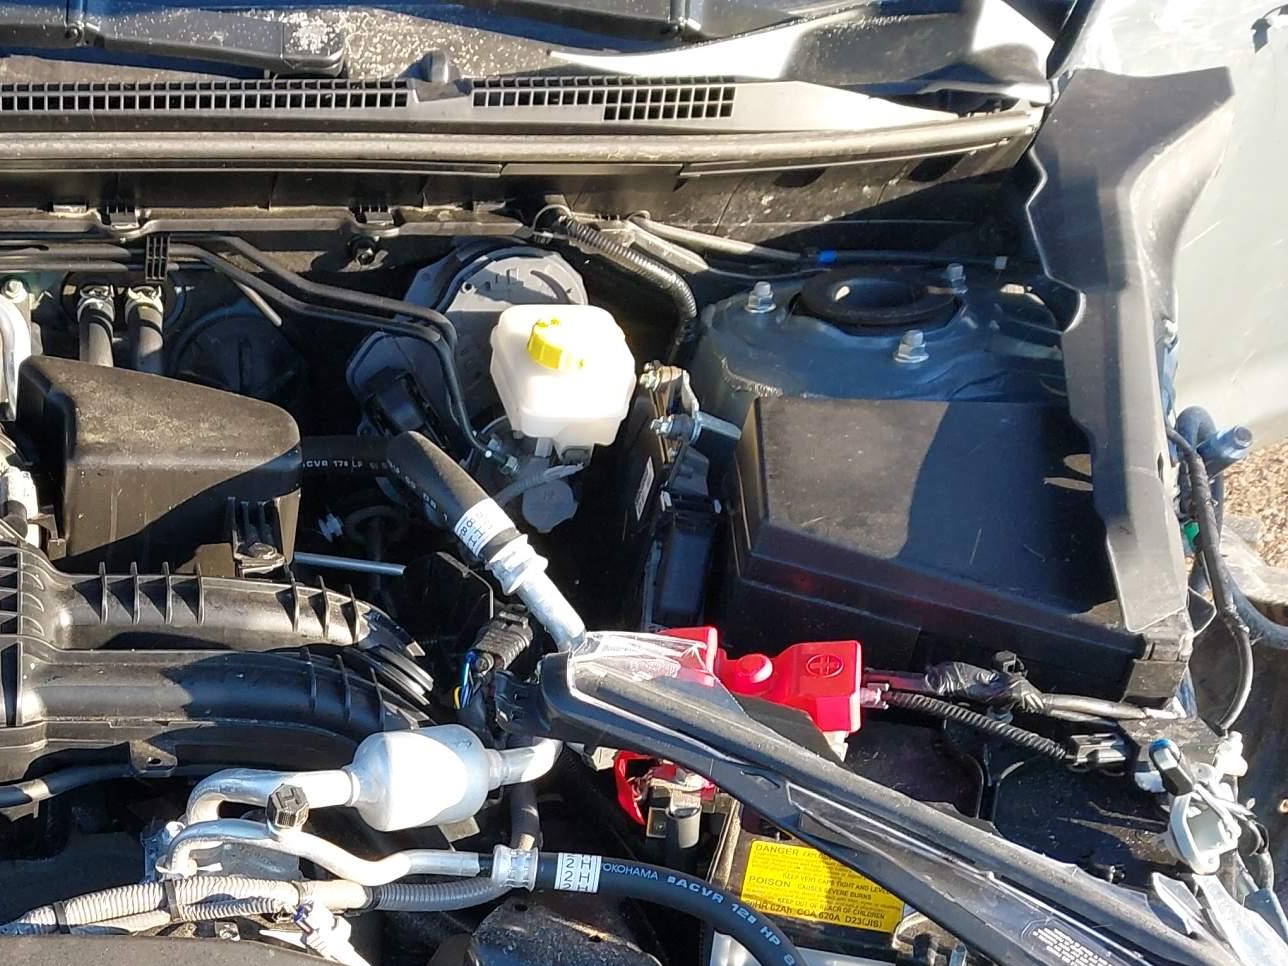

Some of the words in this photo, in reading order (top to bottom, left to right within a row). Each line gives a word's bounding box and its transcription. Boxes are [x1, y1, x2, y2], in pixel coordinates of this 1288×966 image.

[755, 844, 799, 857] DANGER
[600, 862, 659, 881] OKOHAMA
[749, 876, 791, 888] POISON
[852, 908, 885, 919] CHILDREN
